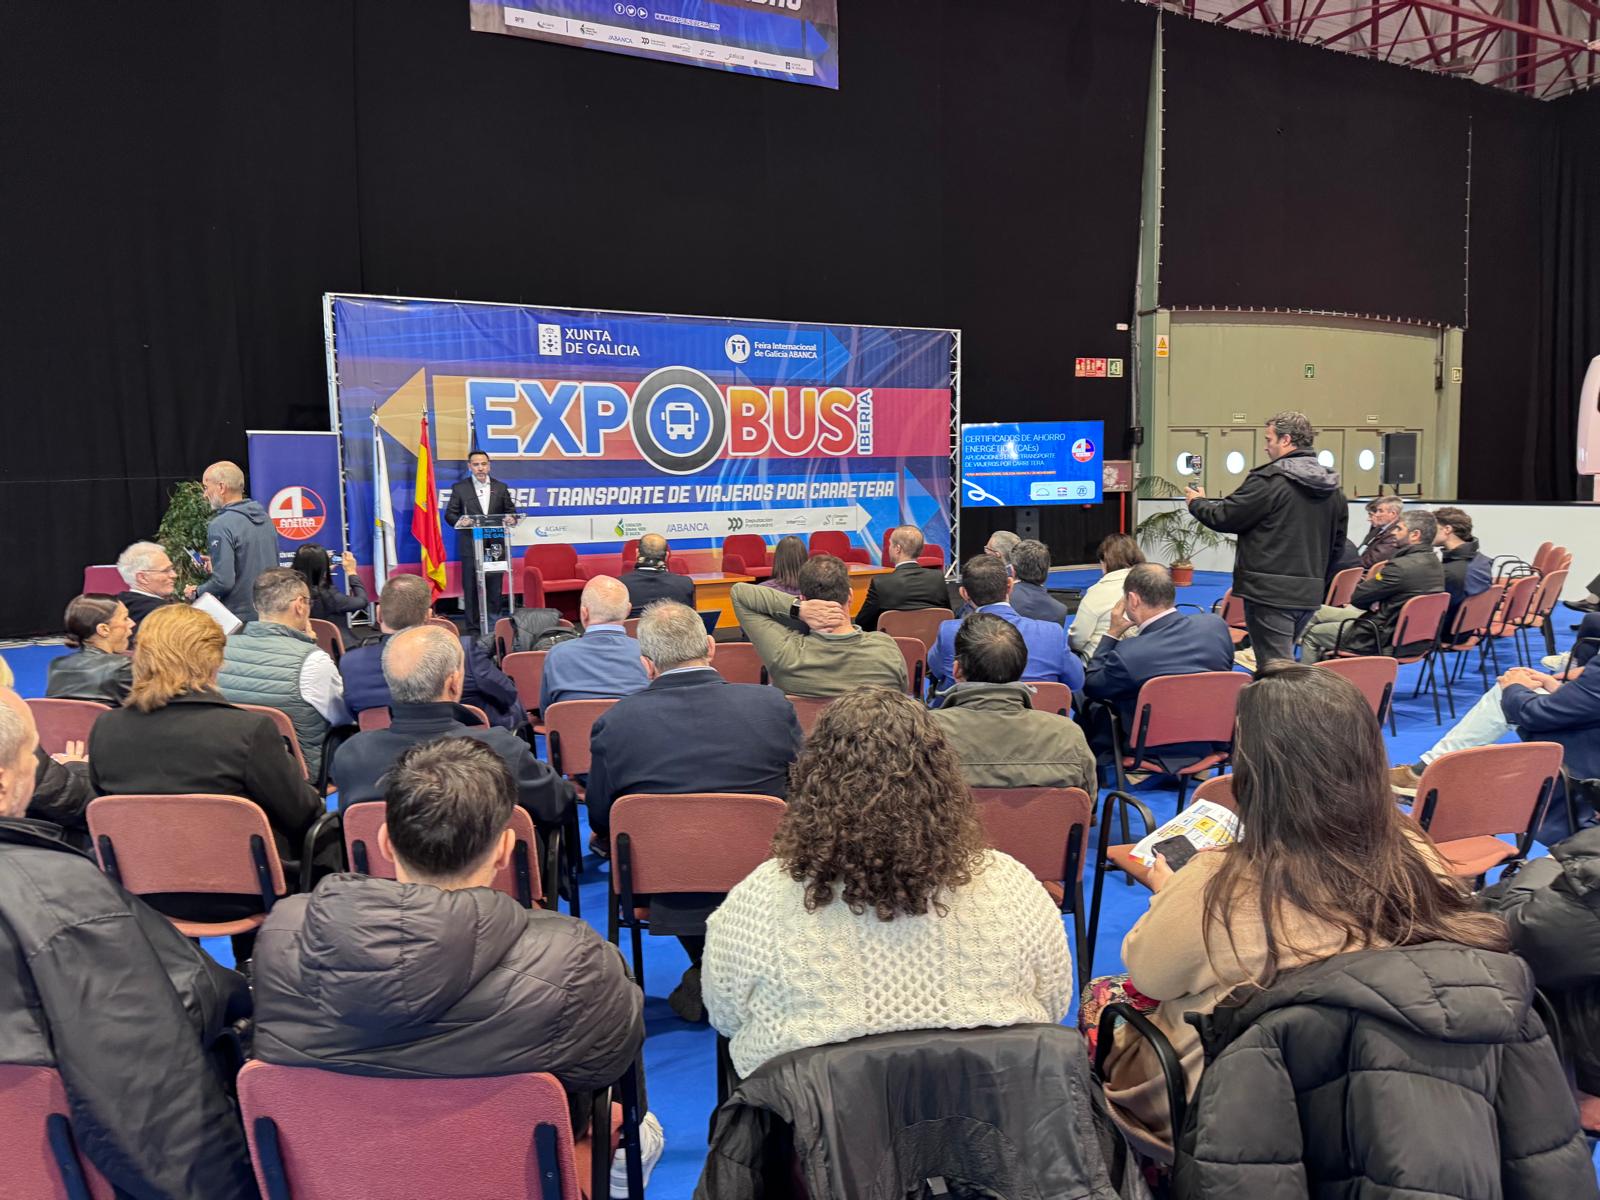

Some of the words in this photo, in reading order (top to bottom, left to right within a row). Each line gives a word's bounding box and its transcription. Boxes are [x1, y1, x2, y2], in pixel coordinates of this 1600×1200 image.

[565, 328, 612, 341] XUNTA
[565, 342, 583, 354] DE
[587, 343, 640, 356] GALICIA
[754, 341, 771, 350] Feira
[772, 342, 817, 351] Internacional
[765, 350, 788, 358] Galicia
[789, 351, 818, 359] ABANCA
[859, 390, 871, 453] IBERIA
[965, 434, 1020, 443] CERTIFICADOS
[1021, 434, 1032, 442] DE
[1033, 433, 1066, 442] AHORRO
[546, 486, 666, 507] TRANSPORTE
[667, 485, 690, 504] DE
[695, 484, 774, 503] VIAJEROS
[775, 482, 809, 501] POR
[811, 480, 895, 500] CARRETERA
[279, 517, 316, 528] ANETRA
[667, 523, 709, 532] ABANCA
